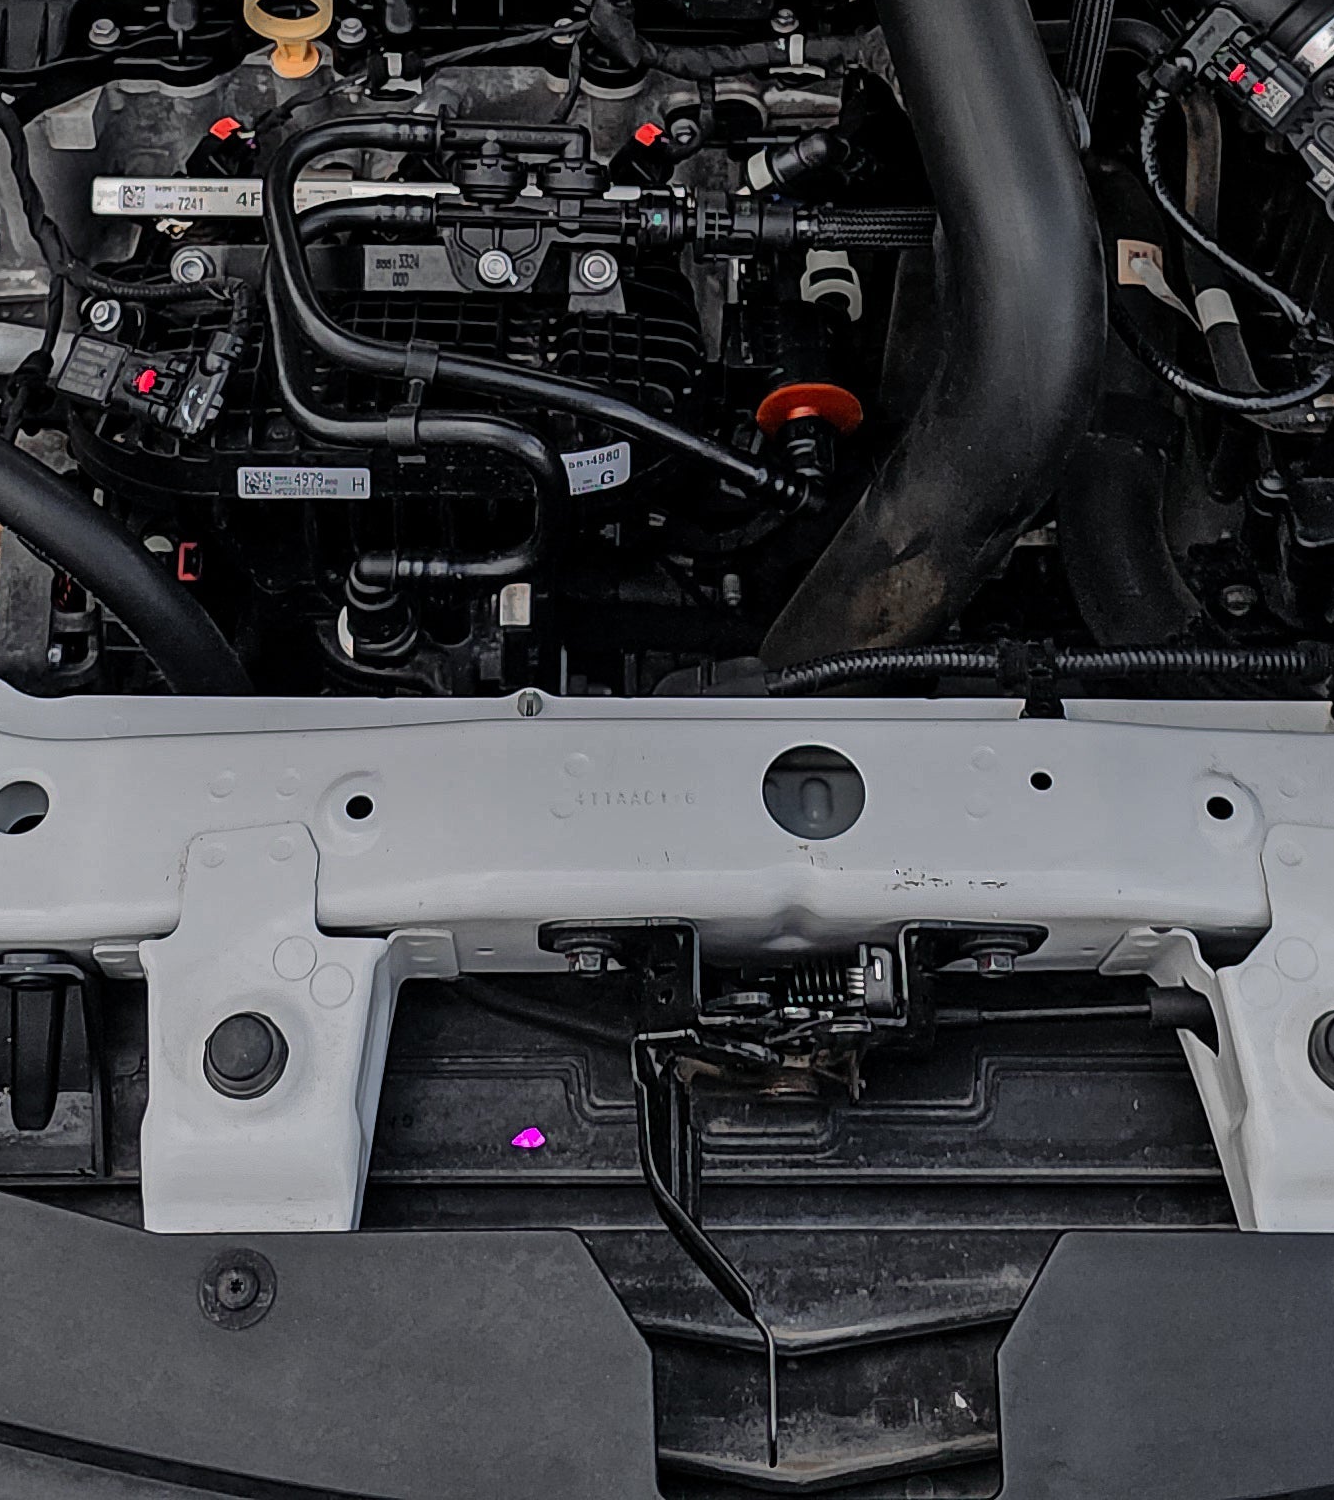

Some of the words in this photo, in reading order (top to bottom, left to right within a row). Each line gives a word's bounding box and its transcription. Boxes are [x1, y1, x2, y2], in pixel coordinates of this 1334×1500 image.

[177, 196, 204, 211] 7241
[294, 472, 324, 488] 4979
[352, 476, 365, 492] H
[600, 469, 615, 485] G
